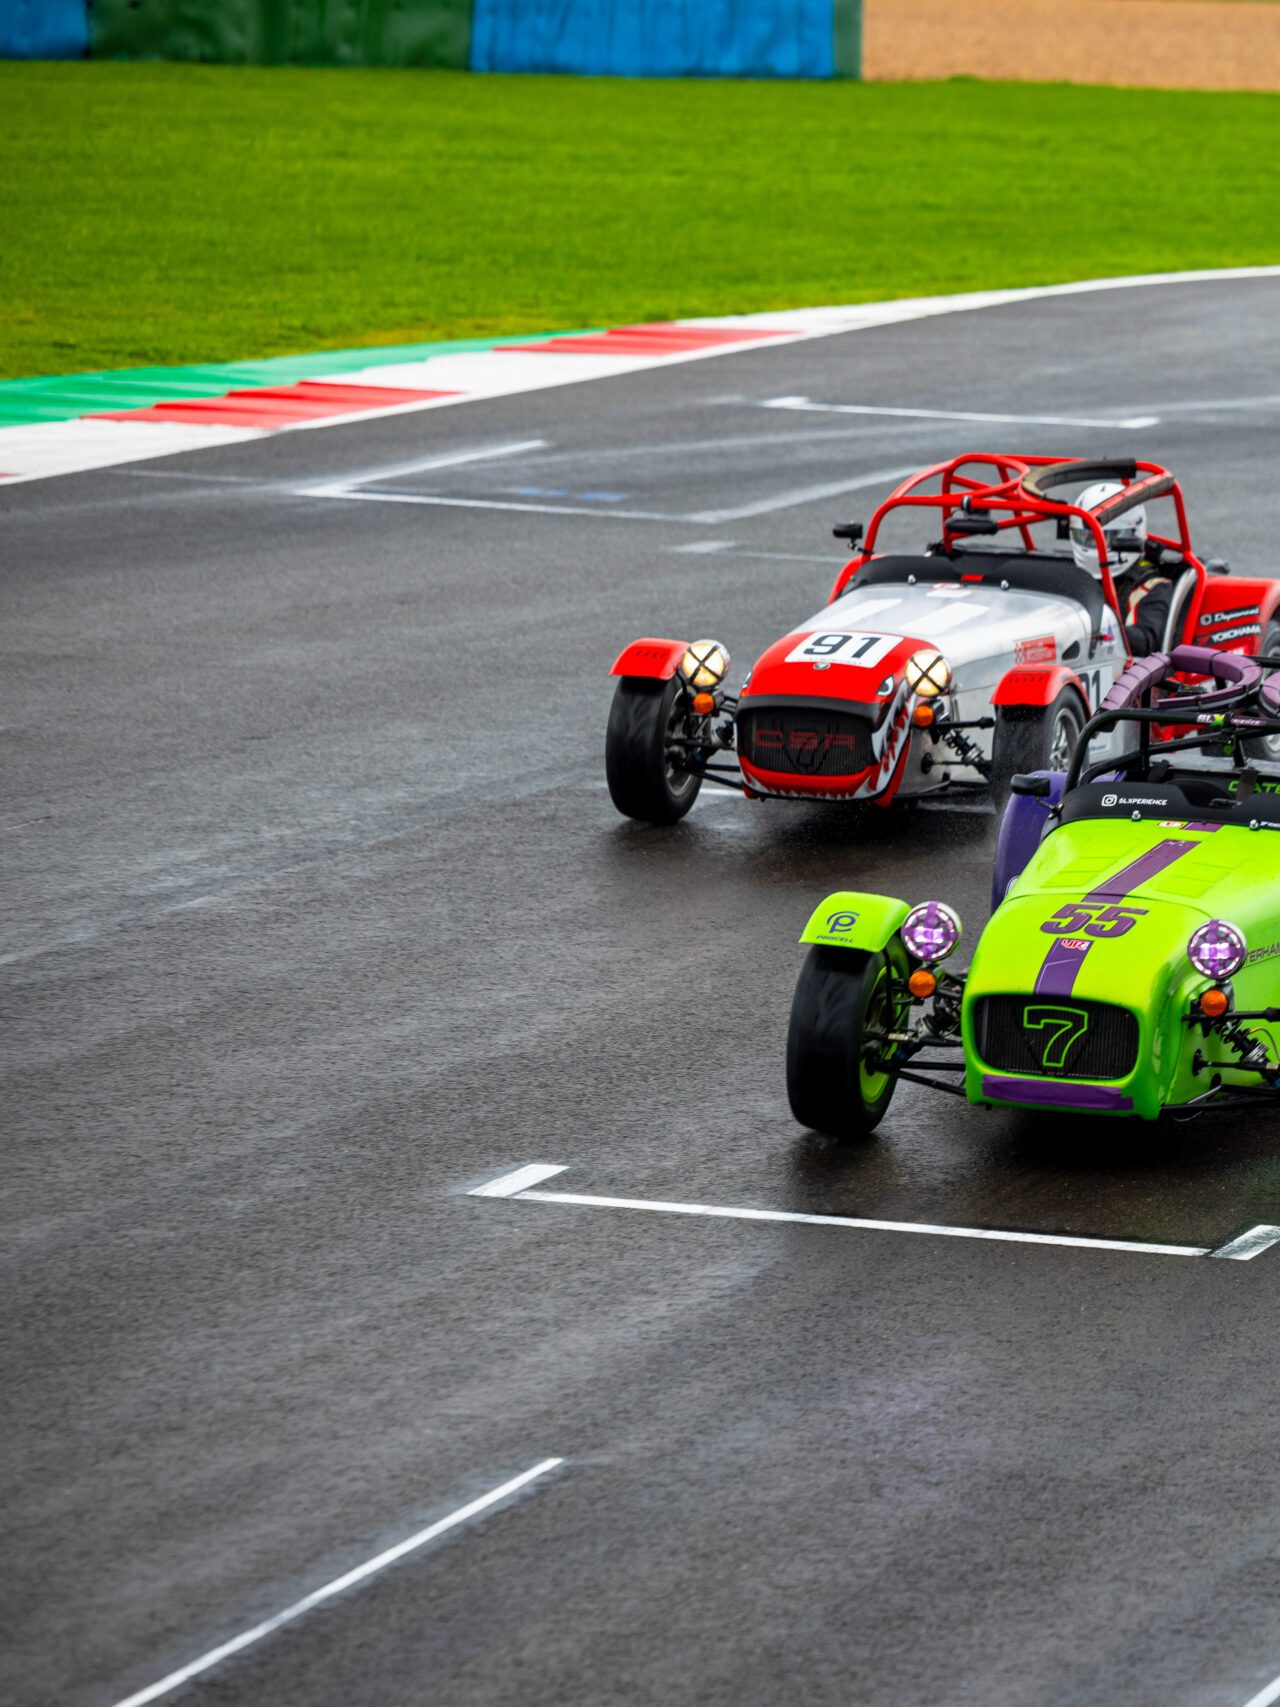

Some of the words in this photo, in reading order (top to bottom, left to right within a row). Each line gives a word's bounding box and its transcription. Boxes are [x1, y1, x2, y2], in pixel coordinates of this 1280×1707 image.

[1211, 624, 1261, 643] YOKOHAMA
[803, 634, 882, 659] 91
[1118, 797, 1168, 806] SLXPERIENCE
[1040, 903, 1150, 938] 55
[1023, 1005, 1088, 1068] 7
